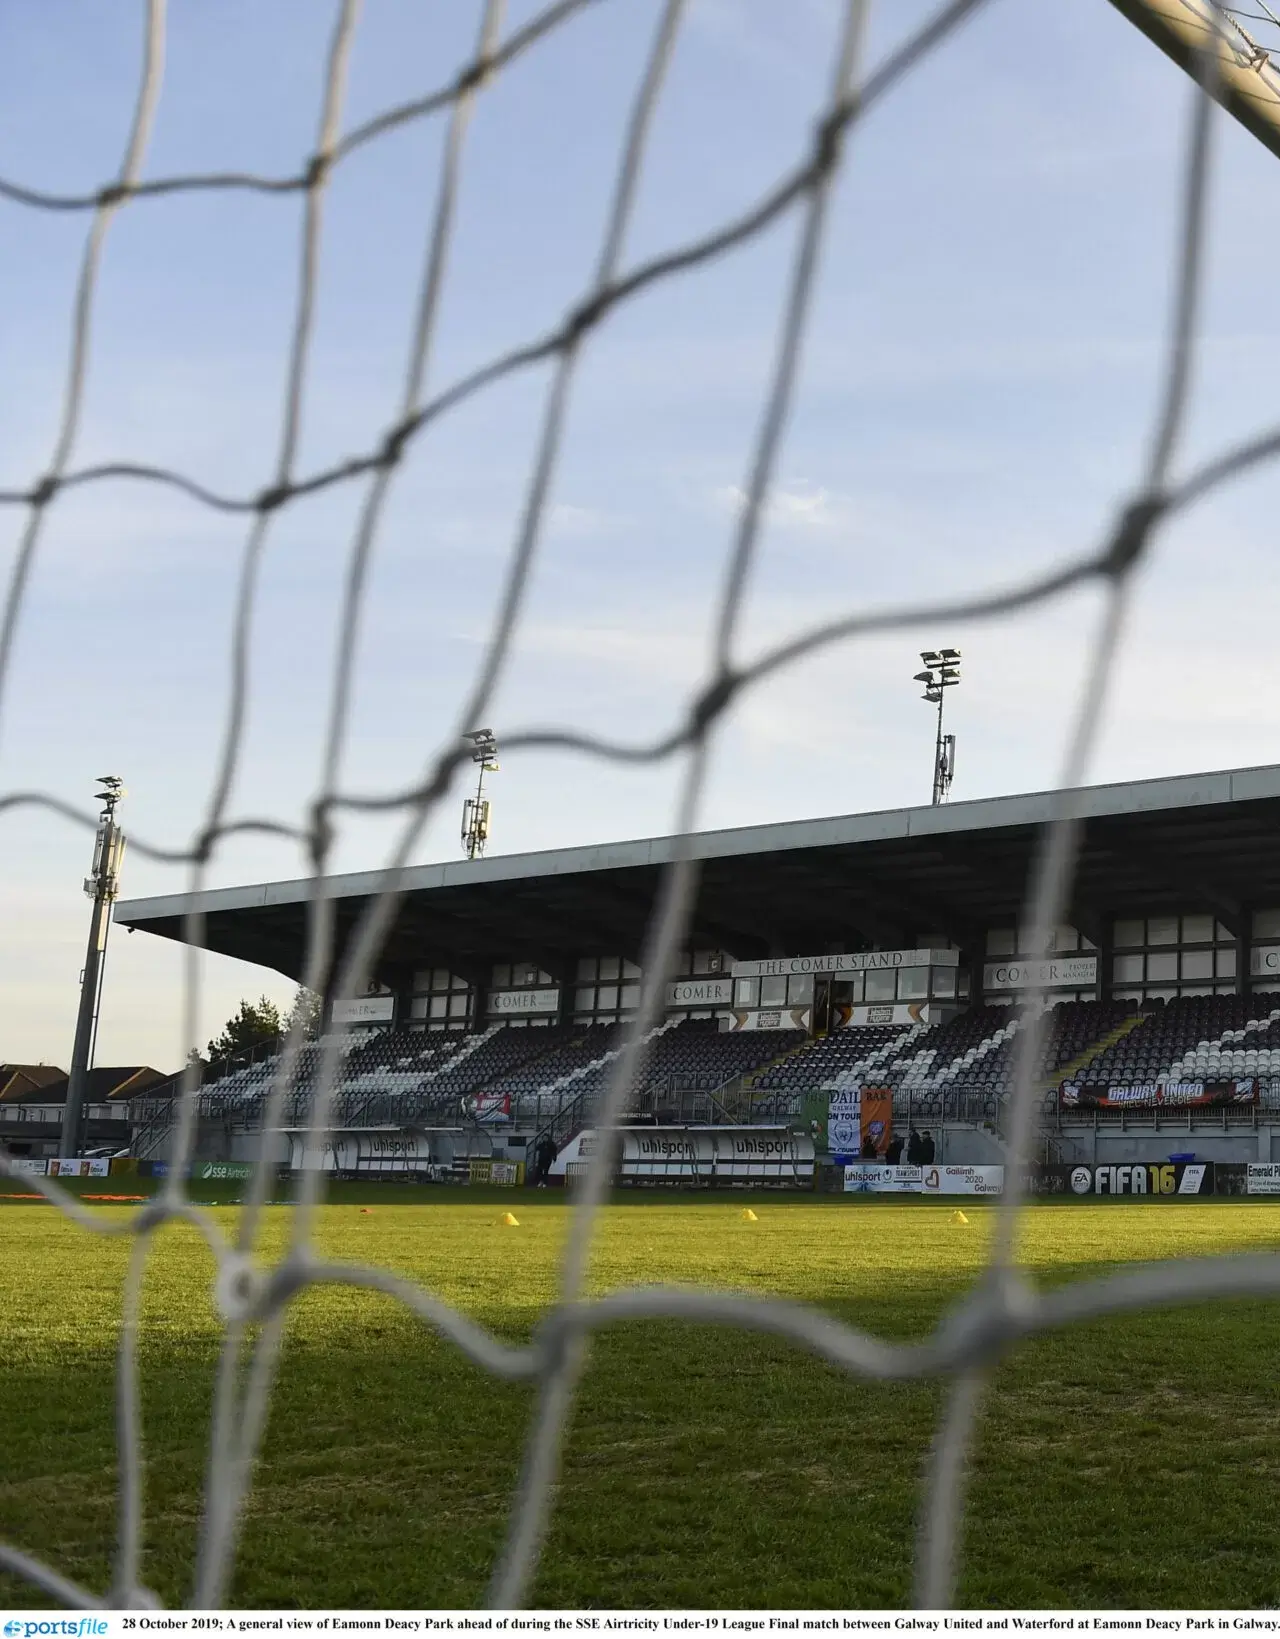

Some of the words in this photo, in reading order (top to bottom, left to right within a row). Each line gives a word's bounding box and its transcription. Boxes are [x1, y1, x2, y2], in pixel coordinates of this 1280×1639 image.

[756, 960, 785, 974] THE
[790, 956, 844, 973] COMER
[850, 952, 903, 968] STAND
[674, 985, 722, 1000] COMER
[494, 994, 537, 1008] COMER
[1108, 1085, 1159, 1101] GALWAY
[1161, 1083, 1205, 1098] UNITED
[827, 1112, 839, 1120] ON
[840, 1112, 861, 1120] TOUR
[212, 1167, 227, 1178] sse
[227, 1167, 256, 1179] Airtricit
[945, 1167, 975, 1176] Gaillimh
[1074, 1172, 1088, 1182] EA
[1248, 1165, 1273, 1177] Emerald
[845, 1171, 881, 1184] uhlsport
[964, 1175, 984, 1184] 2020
[1095, 1165, 1147, 1194] FIFA
[1149, 1165, 1175, 1194] 16
